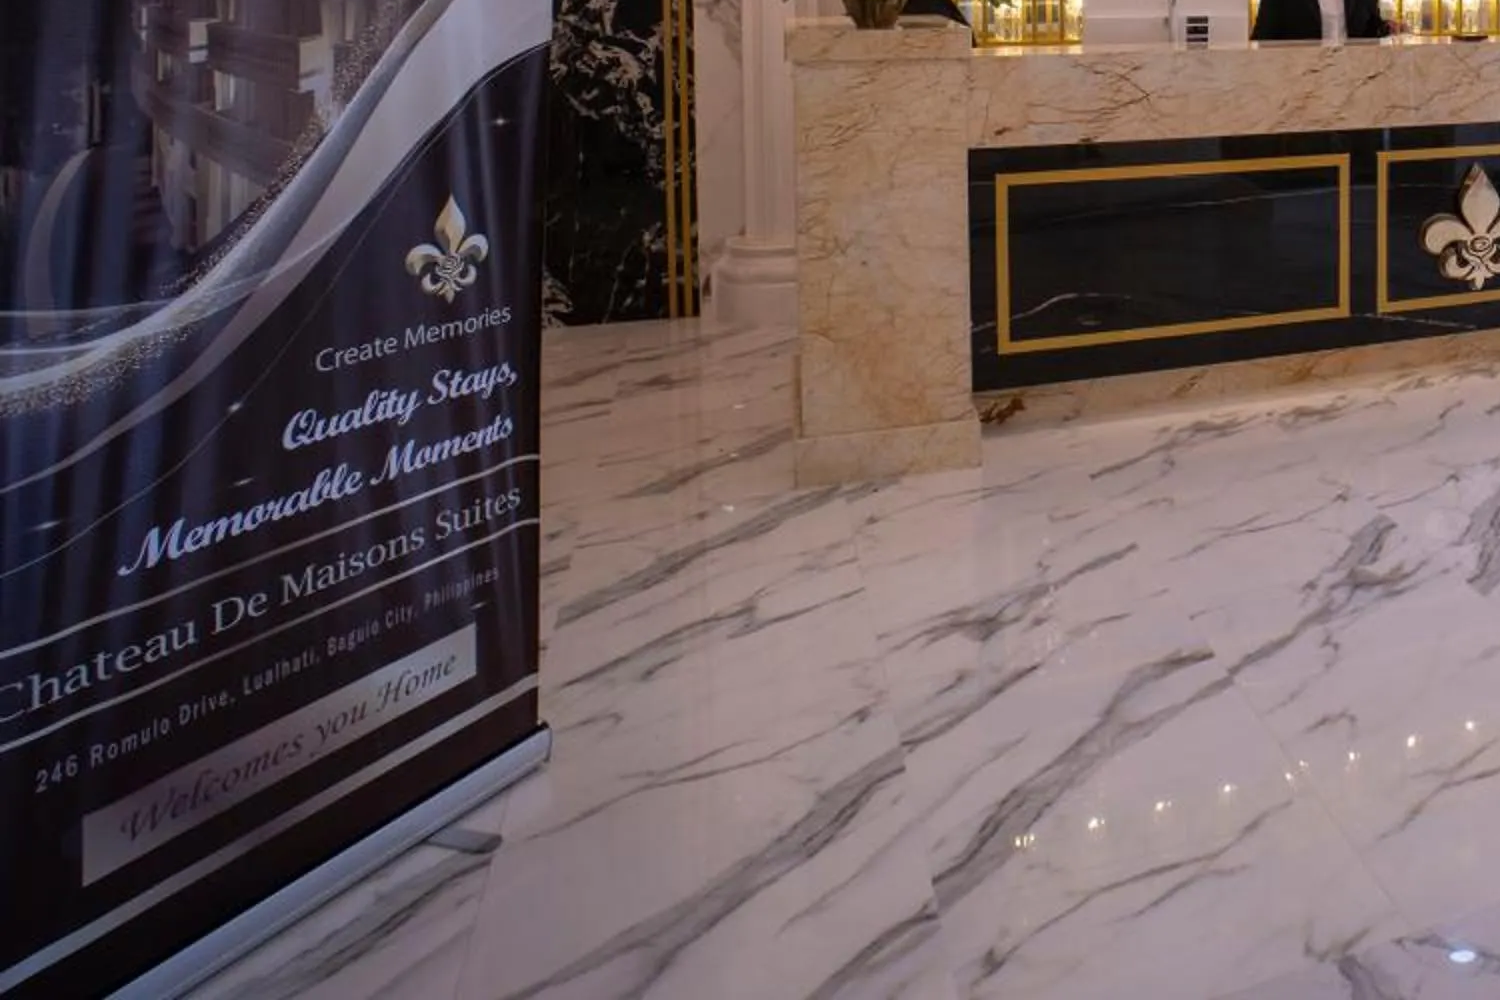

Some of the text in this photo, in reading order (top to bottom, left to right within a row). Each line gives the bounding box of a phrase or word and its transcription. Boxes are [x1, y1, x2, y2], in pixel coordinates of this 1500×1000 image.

[282, 360, 518, 451] Quality Stays,
[315, 305, 512, 372] Create Memories
[117, 415, 514, 576] Memorable Moments
[211, 588, 269, 635] De
[281, 530, 425, 606] Maisons
[434, 486, 522, 540] Suites
[34, 754, 79, 795] 246
[89, 717, 170, 770] Romulo
[327, 616, 381, 657] Baguio
[424, 565, 500, 613] Philippines
[119, 653, 458, 842] Welcomes you Home
